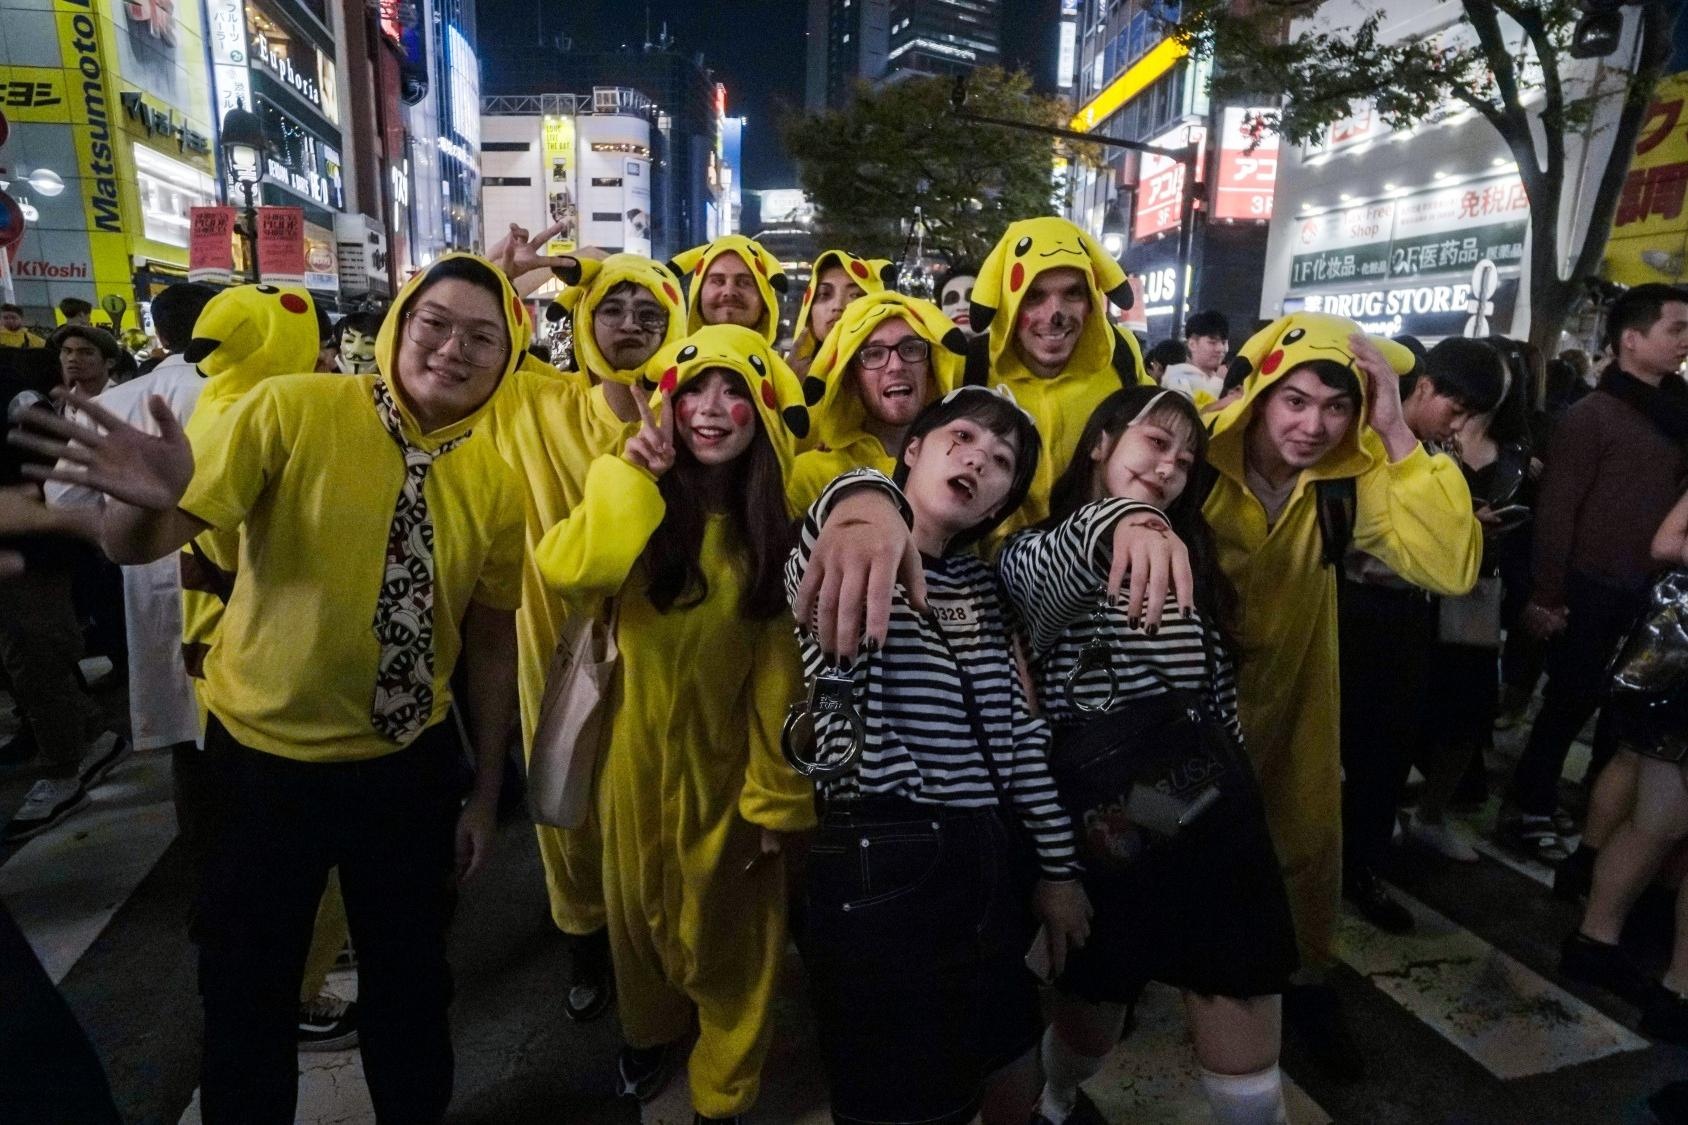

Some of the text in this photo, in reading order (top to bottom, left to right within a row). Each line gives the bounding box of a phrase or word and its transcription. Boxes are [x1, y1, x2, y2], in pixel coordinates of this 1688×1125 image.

[226, 4, 239, 42] フルーツ
[259, 33, 319, 104] Euphoria
[0, 81, 62, 106] ヨシ
[73, 14, 122, 233] Matsumoto
[1457, 184, 1530, 220] 免税店
[1351, 223, 1380, 239] Shop
[16, 260, 87, 278] KiYoshi
[1325, 292, 1385, 317] DRUG
[1386, 284, 1471, 315] STORE
